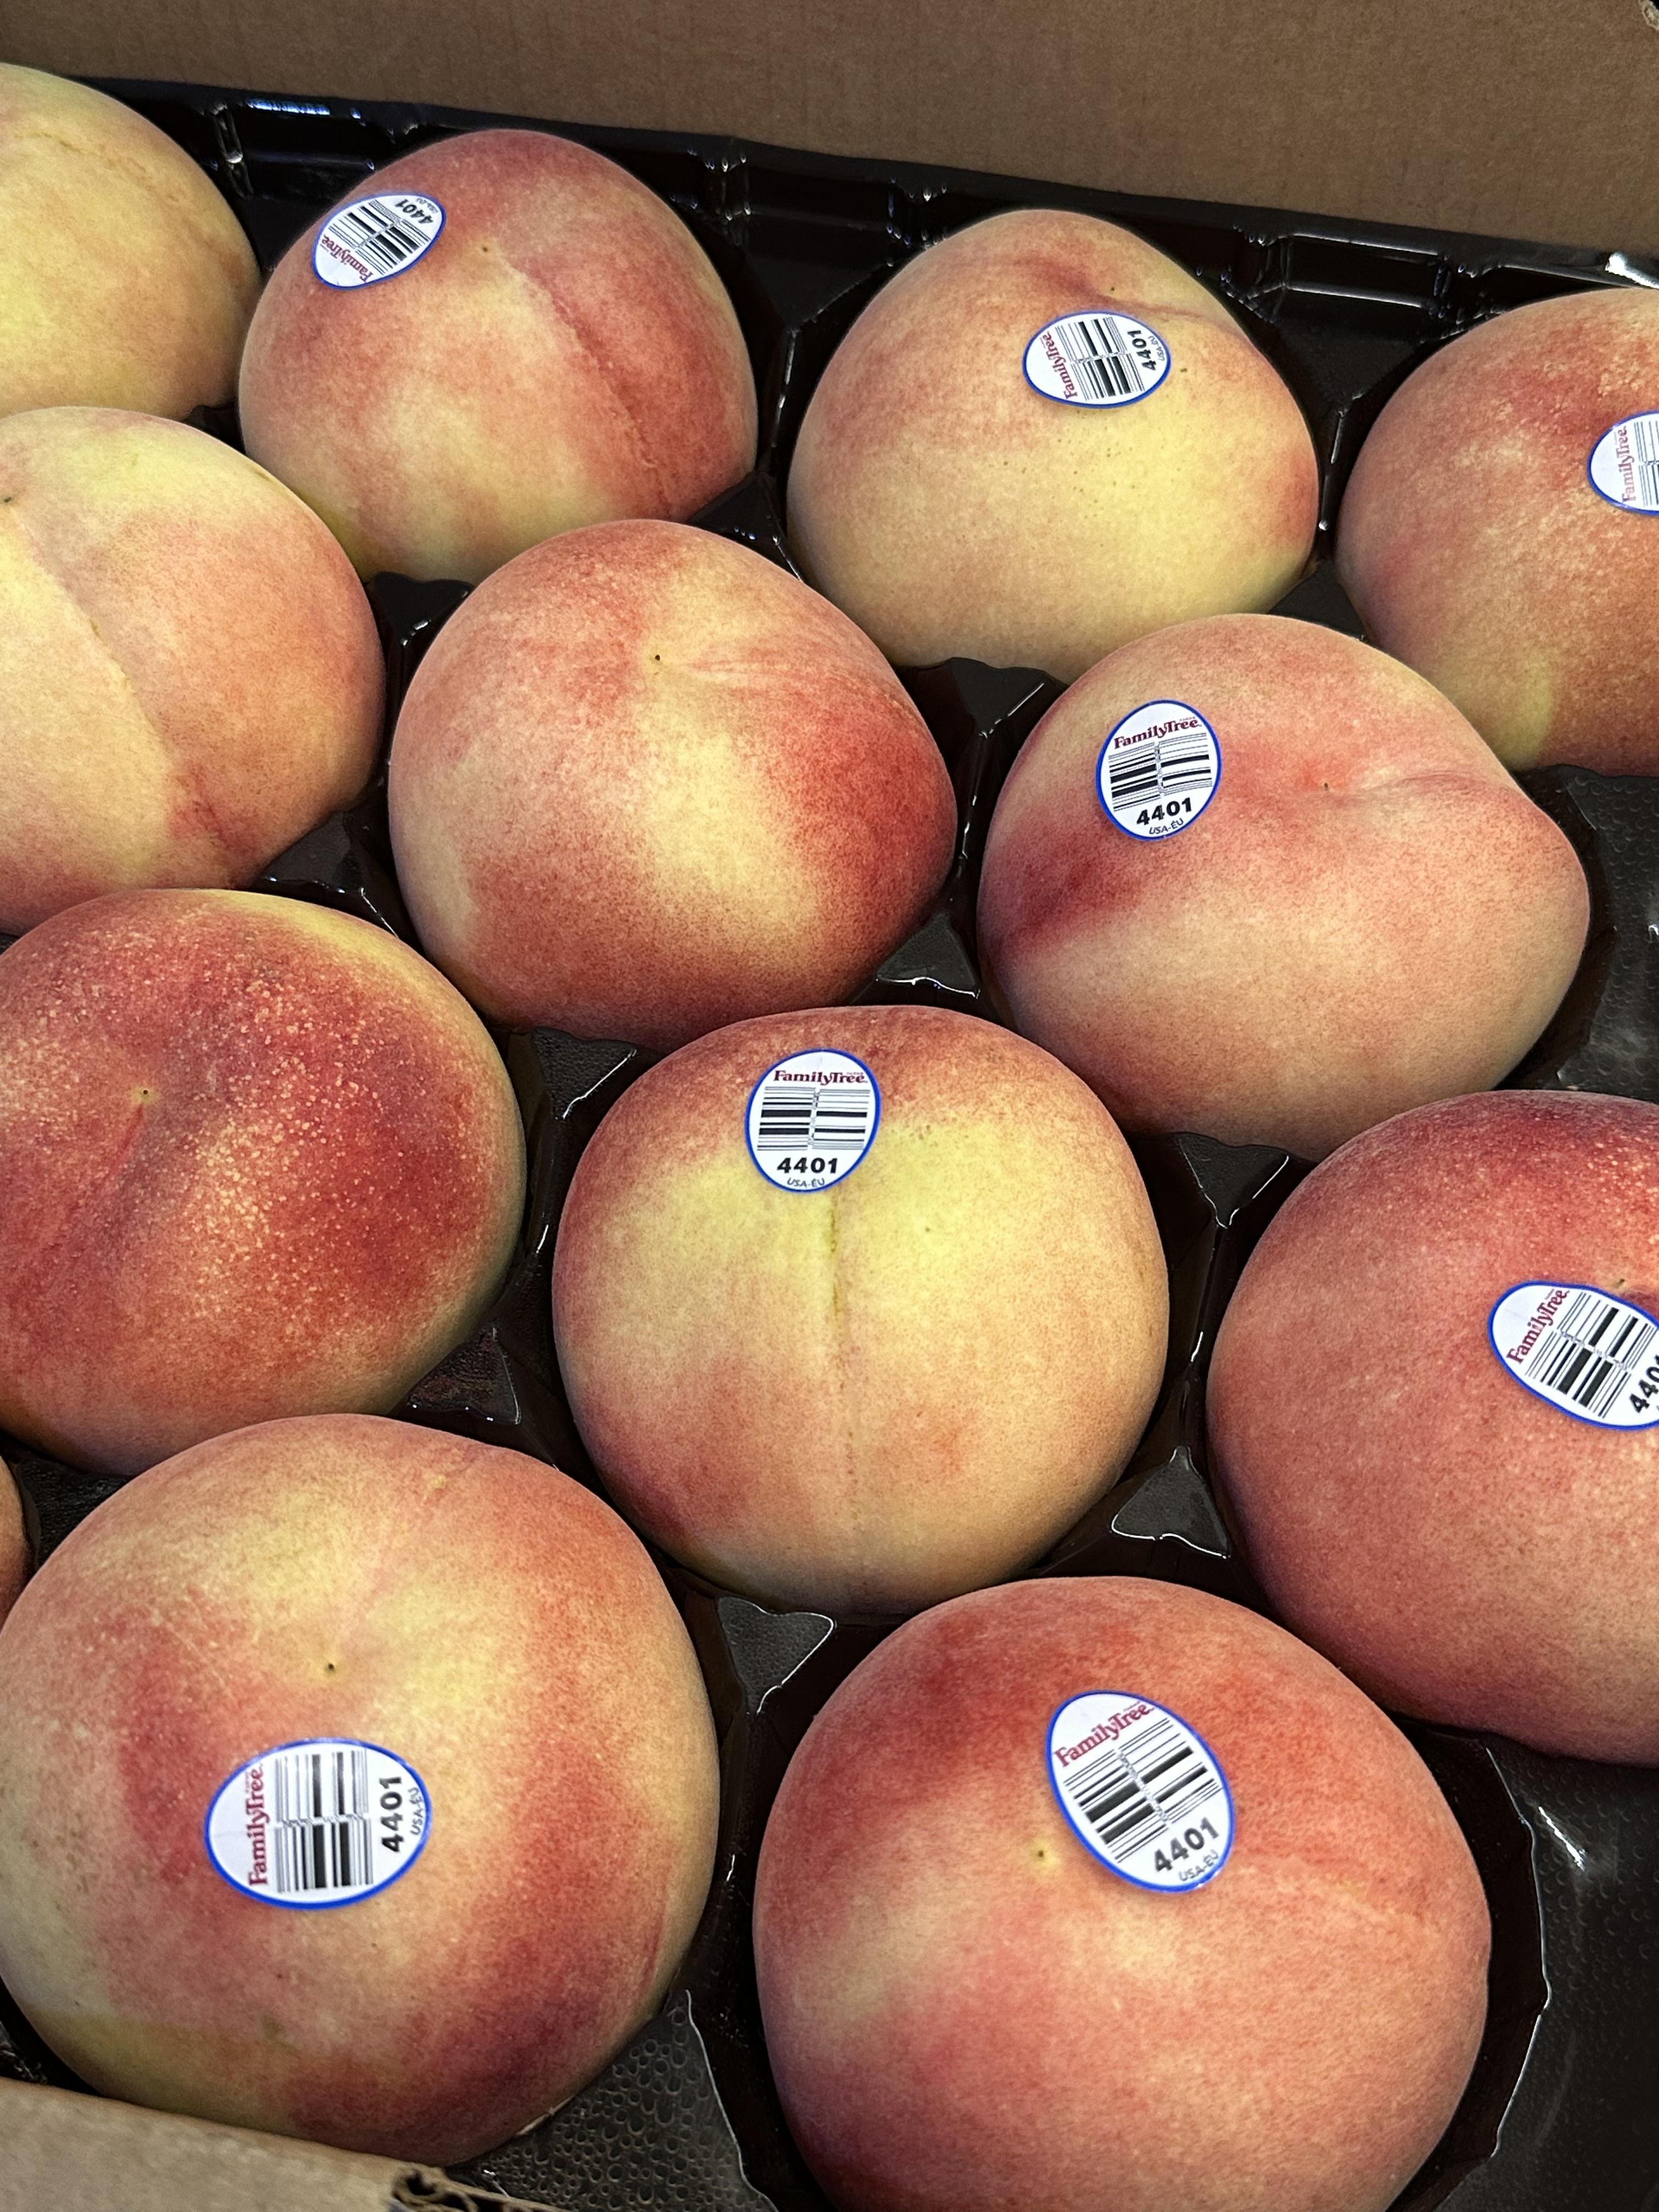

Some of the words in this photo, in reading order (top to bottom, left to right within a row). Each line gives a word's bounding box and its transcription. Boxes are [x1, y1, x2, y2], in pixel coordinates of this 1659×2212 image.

[395, 199, 433, 224] 4401
[321, 235, 374, 282] FamilyTree
[1042, 331, 1077, 399] FamilyTree
[1127, 330, 1156, 371] 4401
[1616, 426, 1637, 503] FamilyTree
[1114, 718, 1198, 749] FamilyTree
[1136, 797, 1192, 826] 4401
[773, 1070, 865, 1086] FamilyTree
[776, 1156, 838, 1173] 4401
[1506, 1289, 1568, 1364] FamilyTree
[1054, 1703, 1150, 1767] FamilyTree
[246, 1768, 270, 1886] FamilyTree
[379, 1776, 405, 1853] 4401
[1154, 1817, 1220, 1872] 4401
